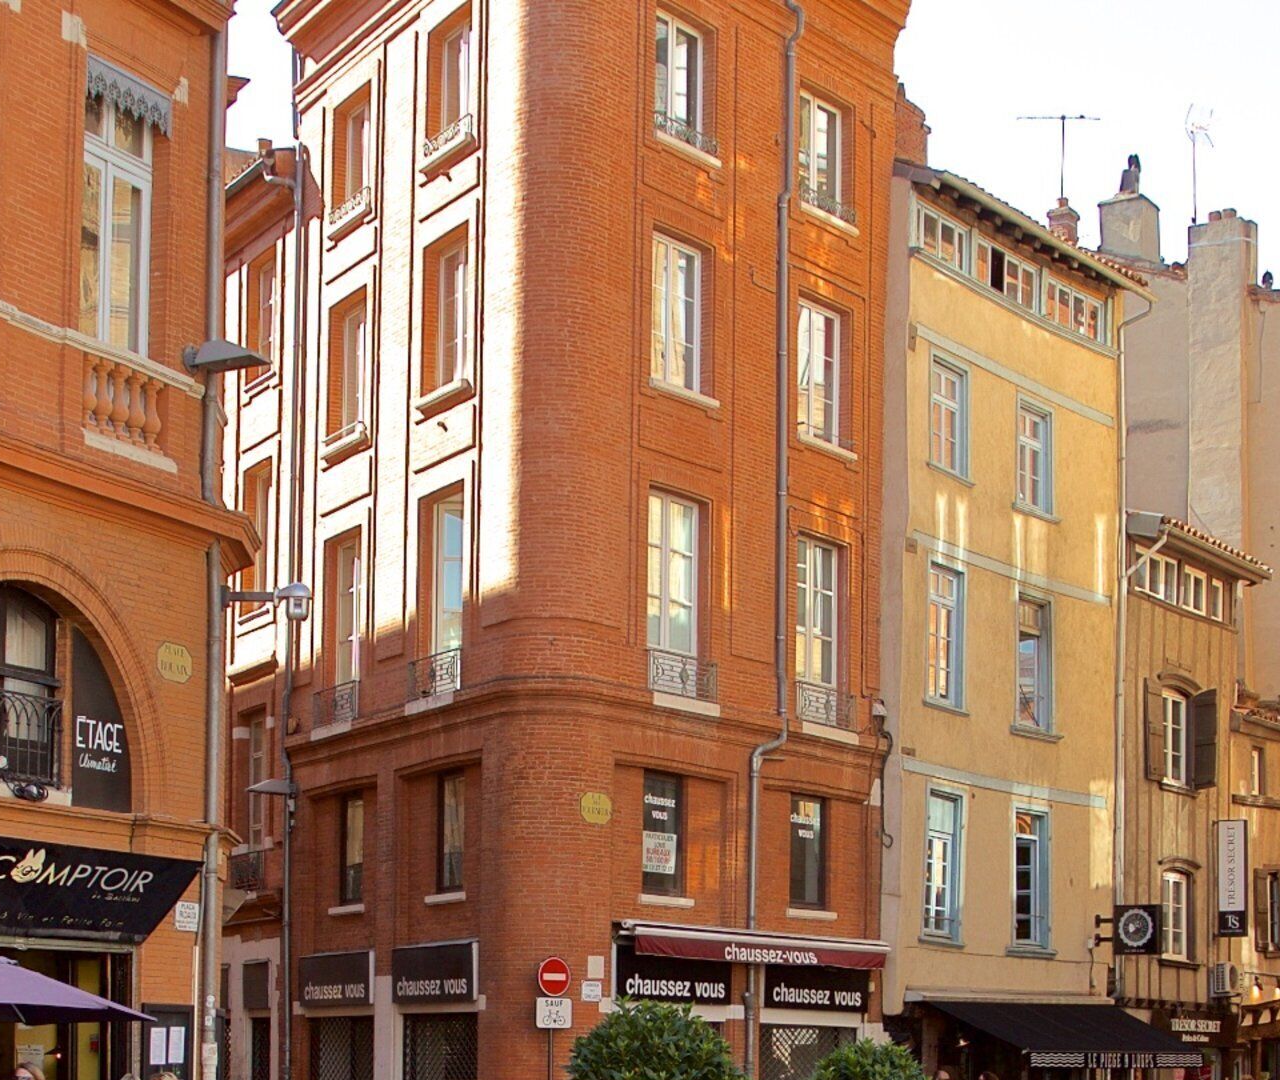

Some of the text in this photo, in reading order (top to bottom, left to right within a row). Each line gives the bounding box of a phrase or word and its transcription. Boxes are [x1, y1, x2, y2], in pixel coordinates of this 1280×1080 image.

[644, 793, 675, 808] chaussez
[651, 810, 668, 820] vous
[725, 943, 818, 964] chaussez-vous
[304, 982, 365, 1000] chaussez vous
[397, 977, 468, 996] chaussez vous
[626, 974, 725, 998] chaussez vous
[773, 983, 862, 1006] chaussez vous
[1088, 1052, 1097, 1068] LE
